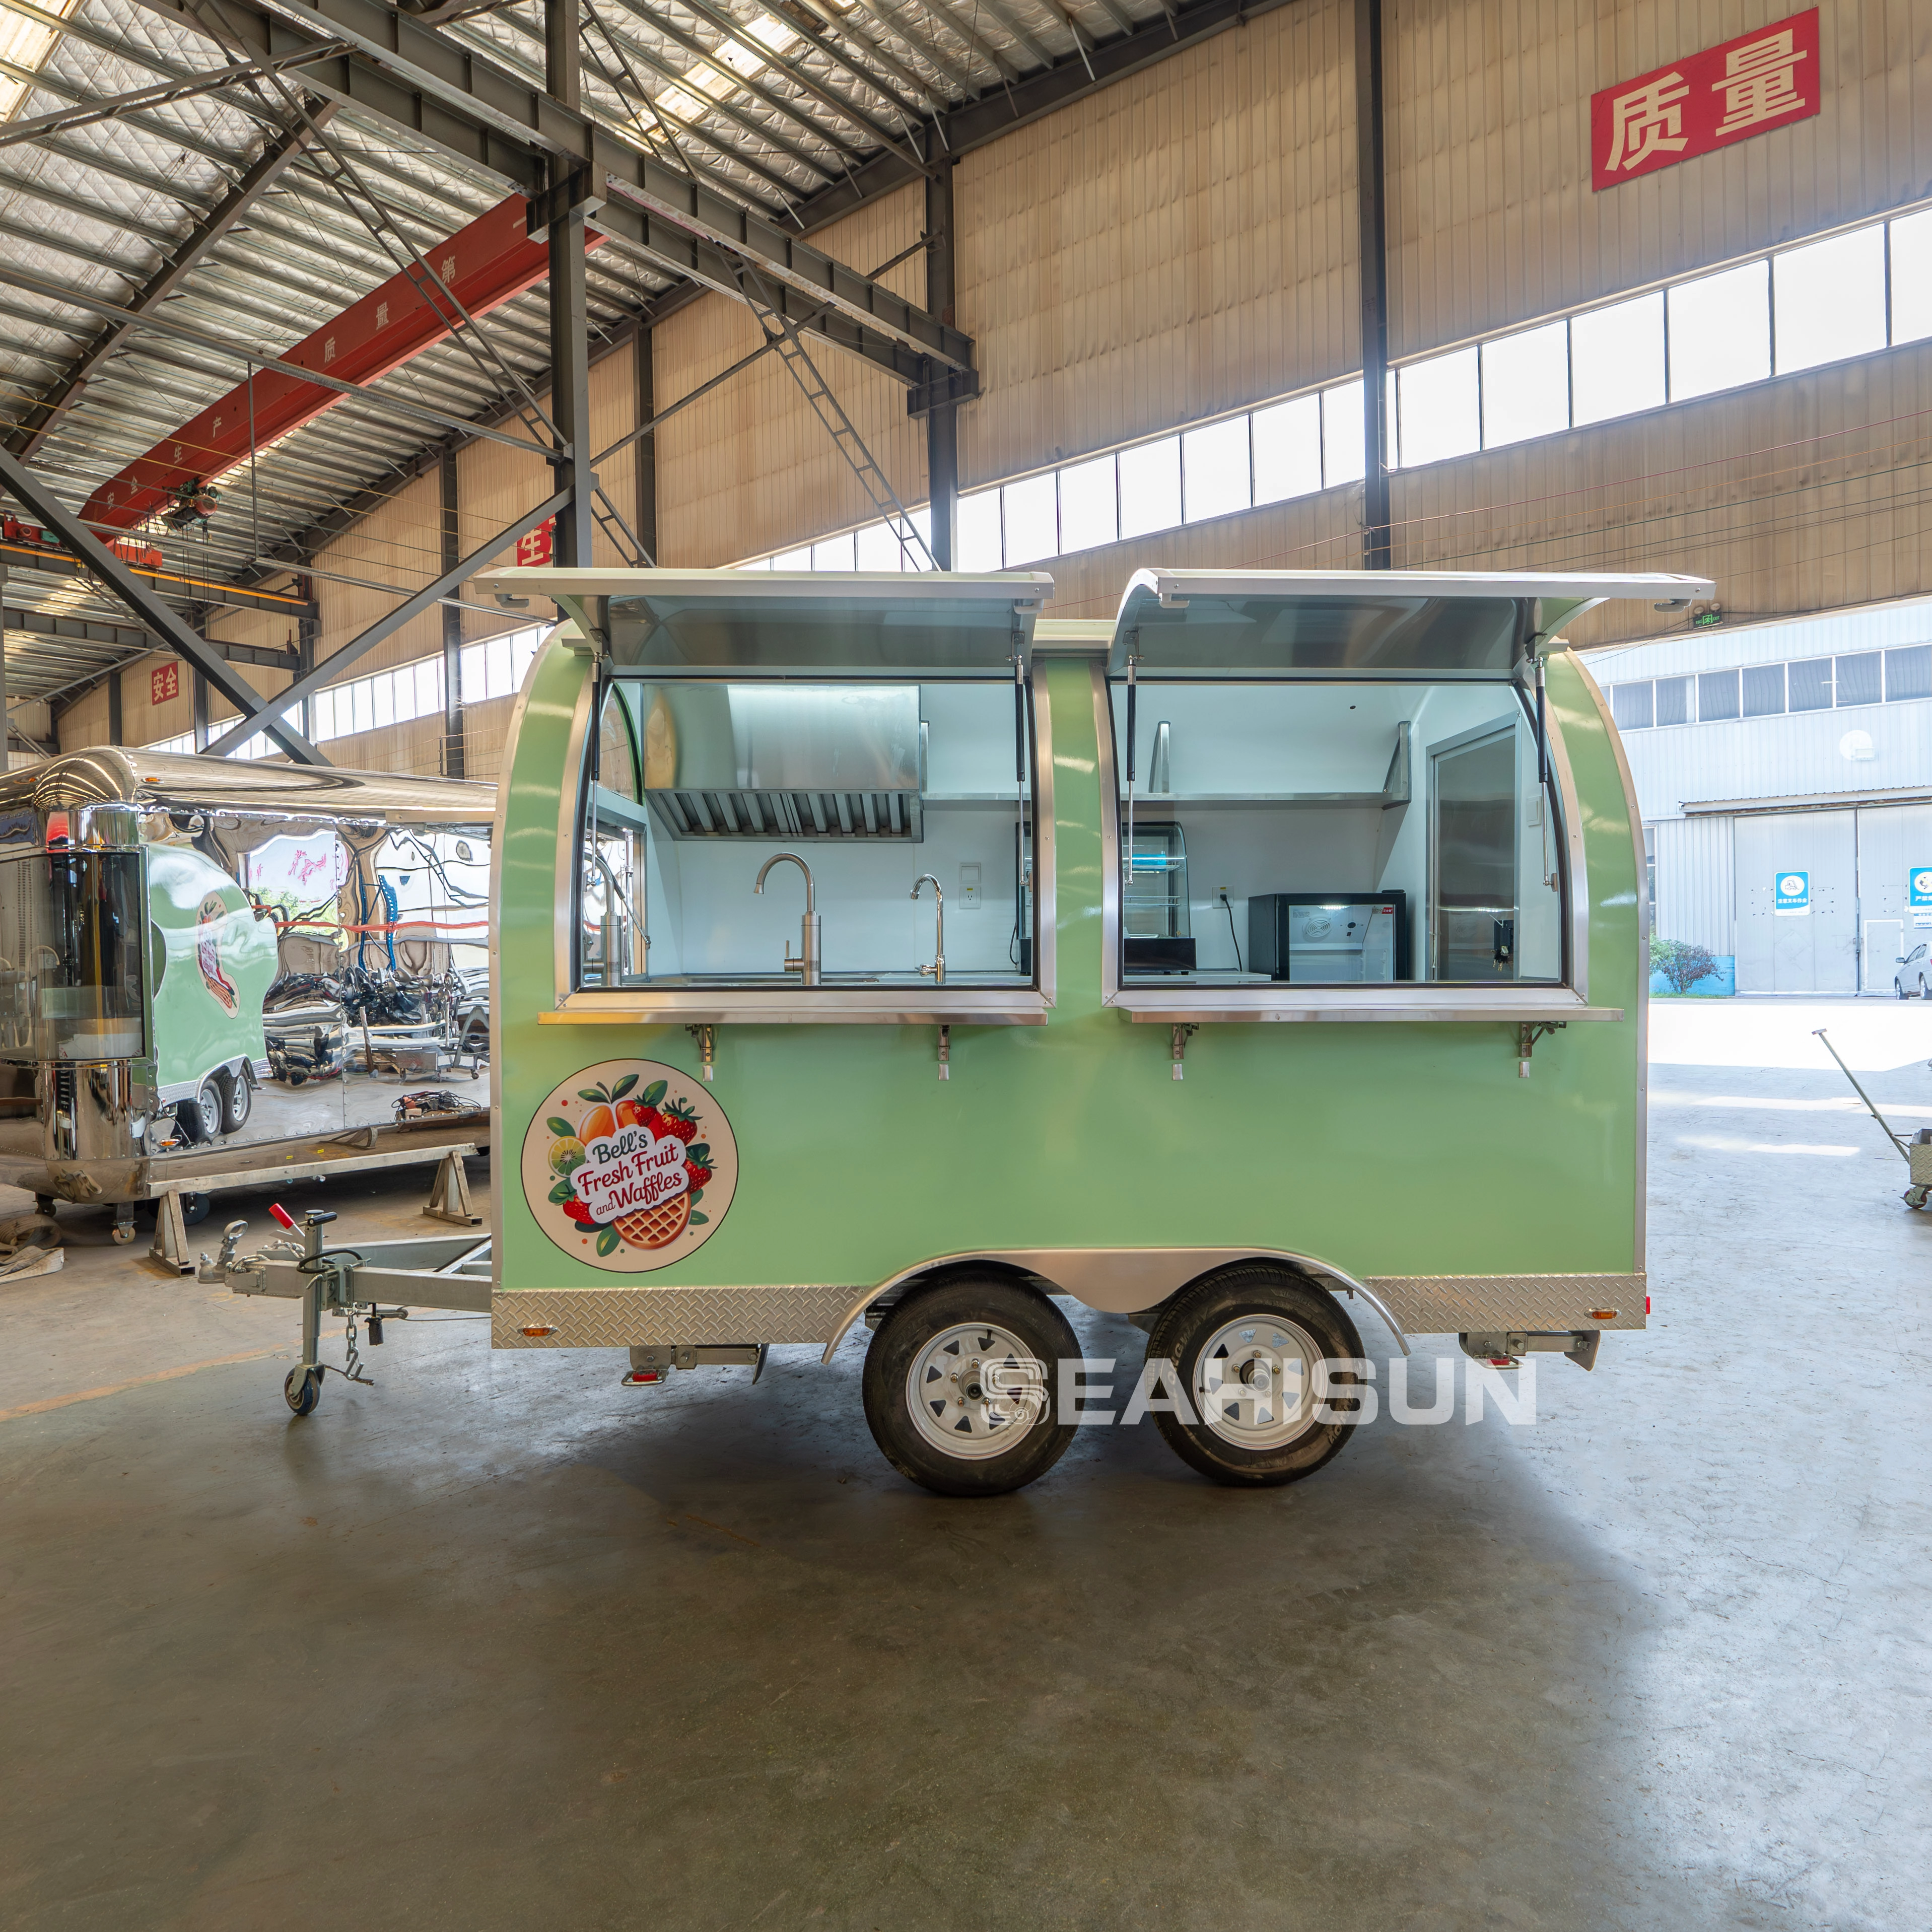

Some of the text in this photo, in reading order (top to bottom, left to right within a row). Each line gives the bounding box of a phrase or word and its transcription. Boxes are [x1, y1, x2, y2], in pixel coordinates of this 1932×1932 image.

[1605, 28, 1807, 171] 质量
[153, 667, 177, 702] 安全
[577, 1143, 679, 1196] Fresh Fruit
[596, 1171, 683, 1215] and Waffles
